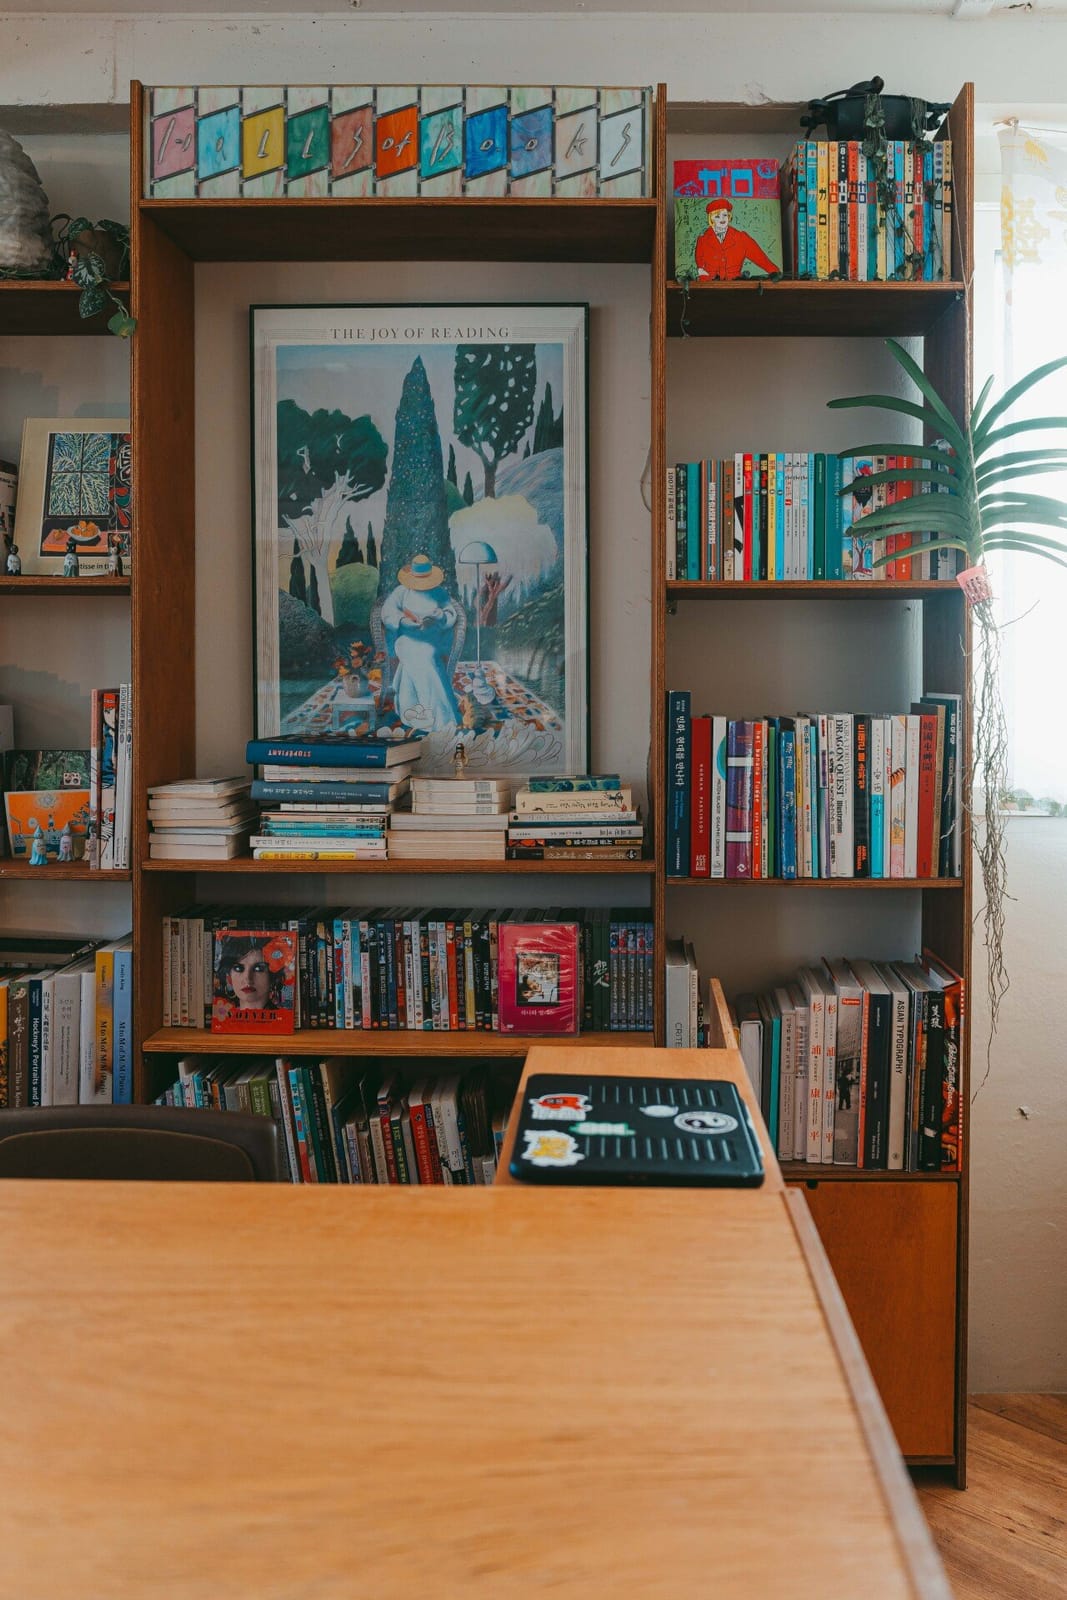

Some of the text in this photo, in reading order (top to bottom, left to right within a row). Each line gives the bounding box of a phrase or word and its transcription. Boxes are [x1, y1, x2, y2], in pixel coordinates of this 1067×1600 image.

[697, 167, 753, 198] ガロ
[329, 327, 510, 341] THE JOY OF READING
[835, 719, 844, 796] DRAGON QUEST
[118, 978, 126, 991] King
[99, 1020, 108, 1030] M
[118, 1021, 126, 1030] M
[31, 1017, 40, 1053] Hockney's
[99, 1037, 108, 1046] M
[118, 1037, 126, 1047] M
[895, 999, 905, 1075] ASIAN TYPOGRAPHY
[31, 1055, 40, 1086] Portraits
[15, 1071, 23, 1085] This
[31, 1086, 40, 1101] and
